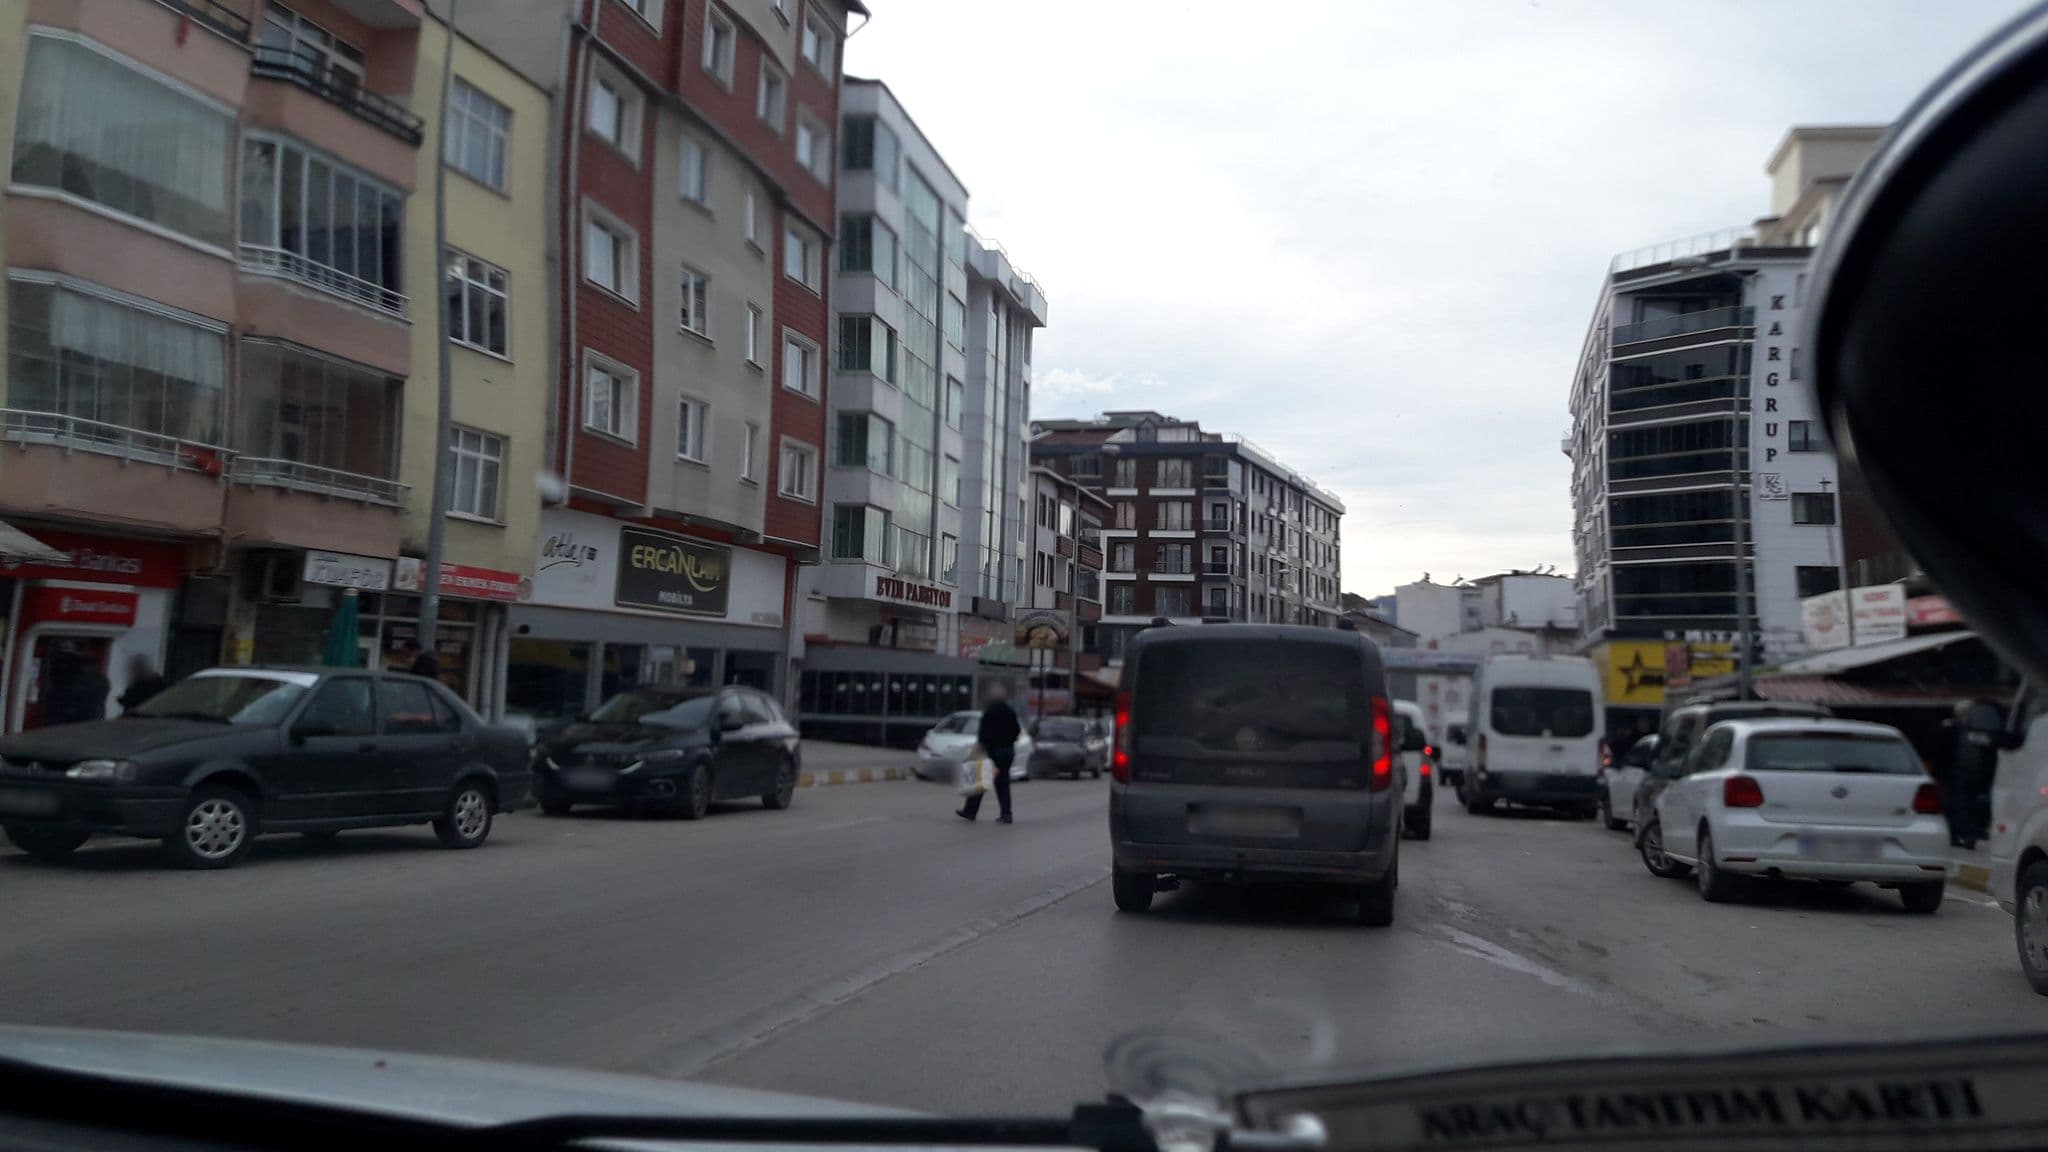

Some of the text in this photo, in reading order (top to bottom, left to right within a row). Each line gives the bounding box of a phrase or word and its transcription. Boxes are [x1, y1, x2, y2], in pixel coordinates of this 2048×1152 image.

[1763, 295, 1785, 463] KARGRUP
[1422, 1079, 1983, 1140] ARAÇ TANITIM KARTI
